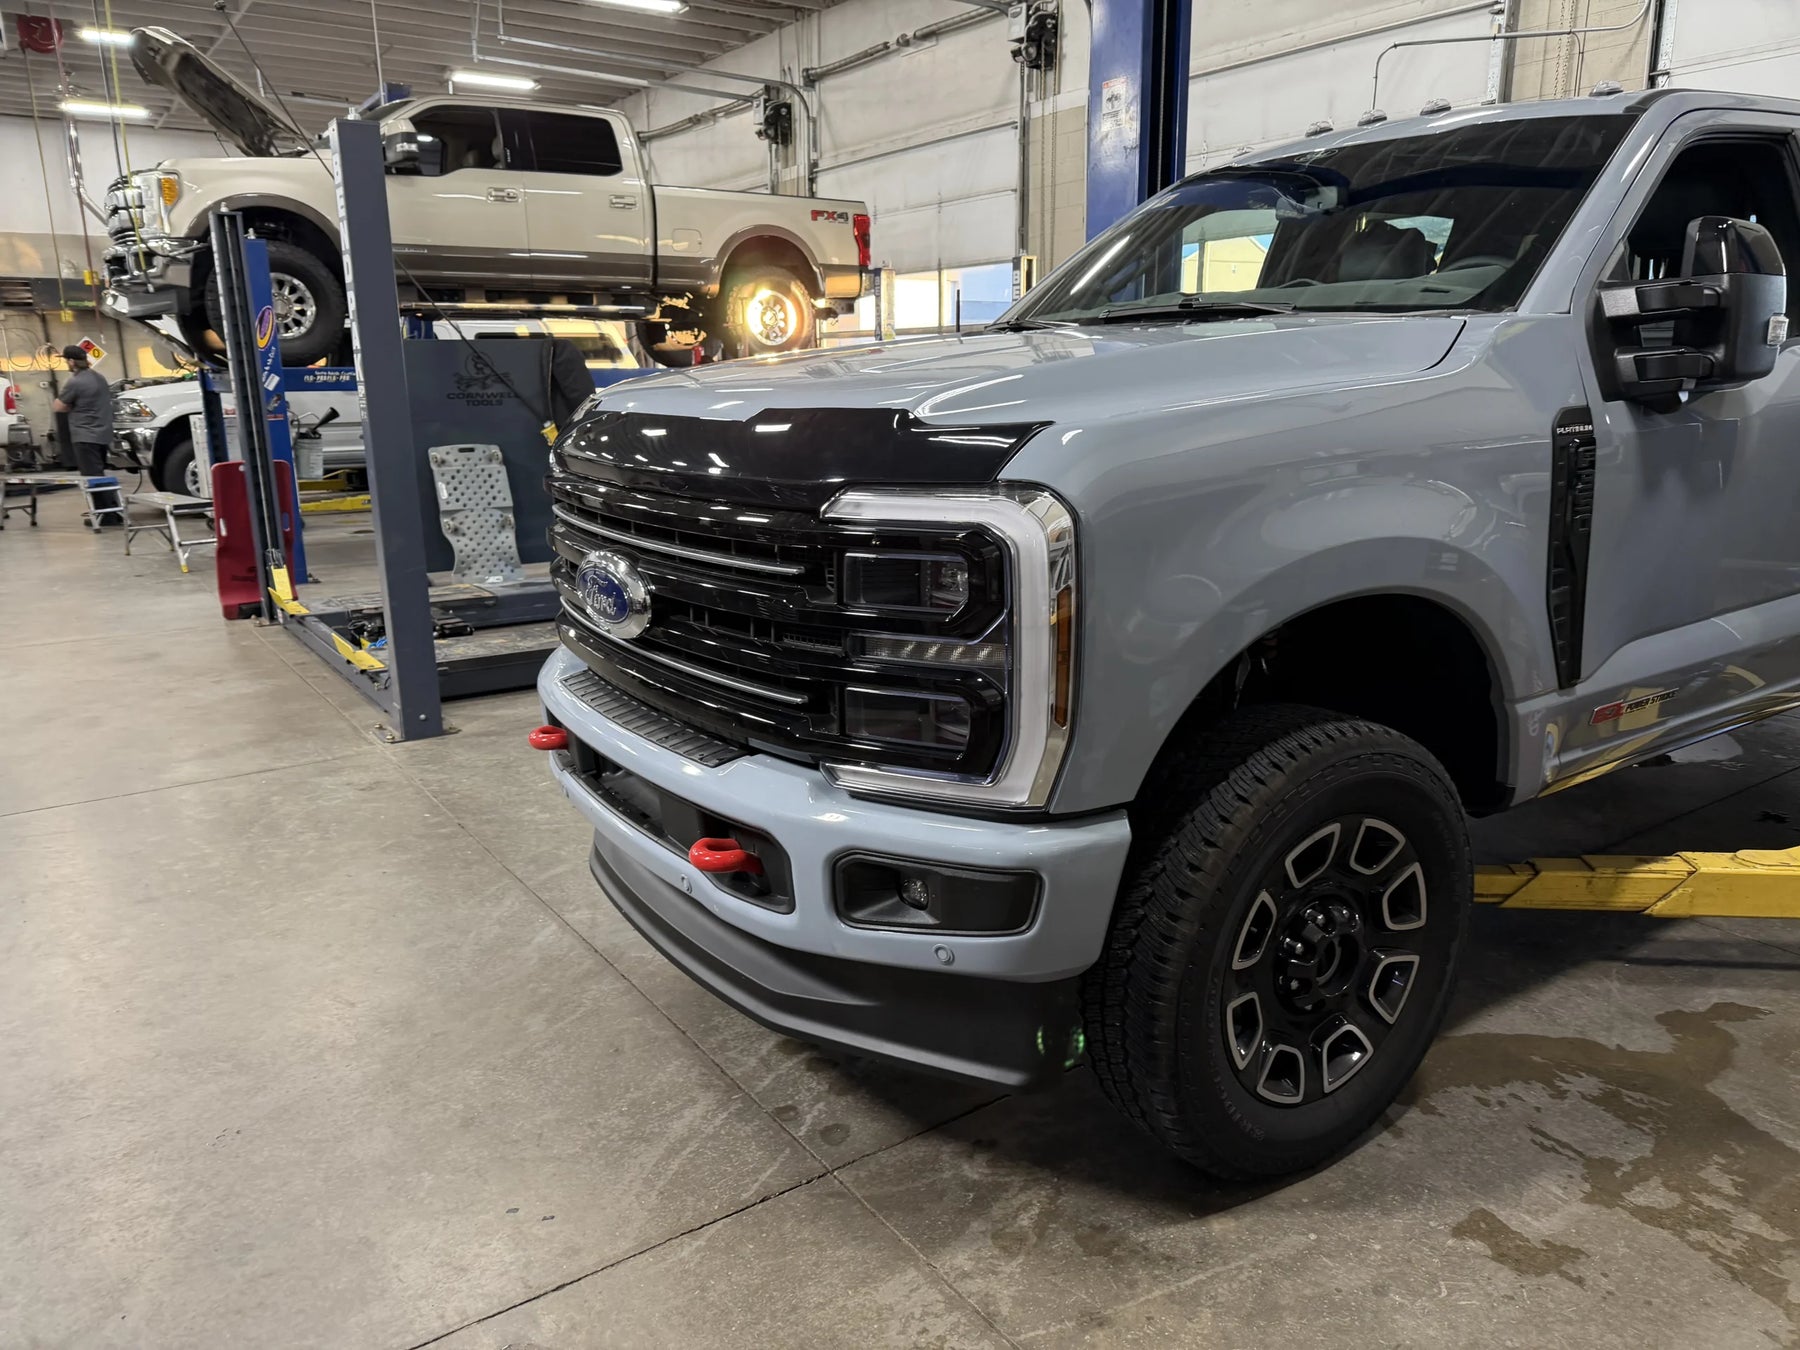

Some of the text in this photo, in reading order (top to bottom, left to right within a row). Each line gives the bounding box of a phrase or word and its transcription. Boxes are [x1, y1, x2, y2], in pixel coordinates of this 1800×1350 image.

[811, 210, 849, 222] FX4
[93, 348, 100, 358] 0
[585, 574, 617, 616] Ford
[1625, 698, 1649, 712] POWER
[1650, 691, 1678, 704] STROKE
